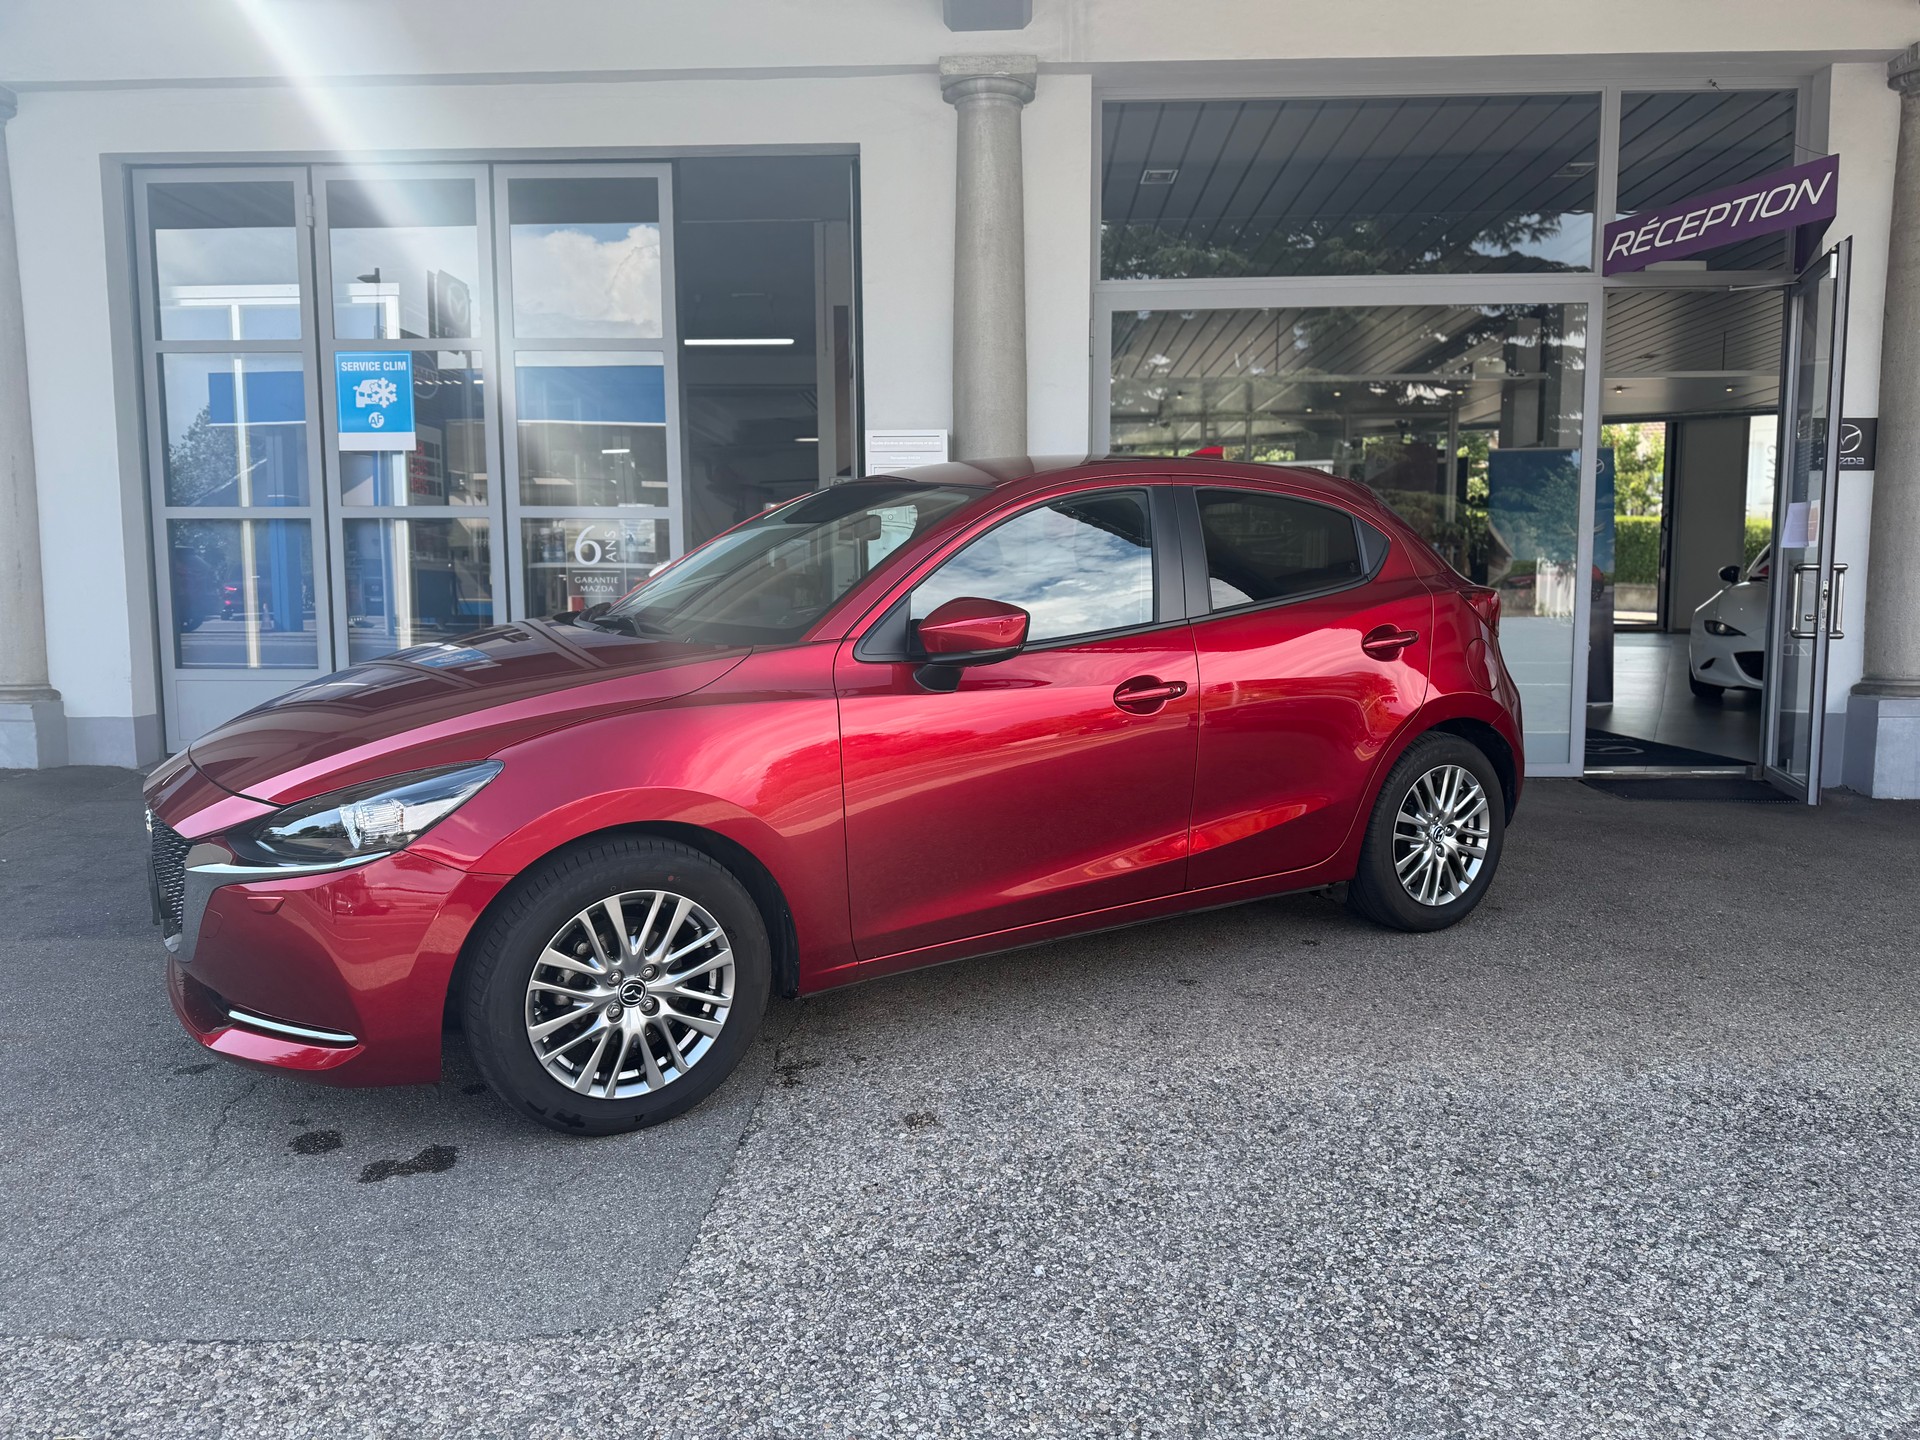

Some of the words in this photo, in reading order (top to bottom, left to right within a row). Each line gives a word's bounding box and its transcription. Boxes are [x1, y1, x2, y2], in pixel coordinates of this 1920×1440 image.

[1606, 171, 1833, 262] RÉCEPTION
[341, 361, 381, 371] SERVICE
[383, 361, 406, 371] CLIM
[370, 414, 383, 426] AF
[574, 525, 602, 566] 6
[604, 530, 617, 562] ANS
[574, 576, 619, 584] GARANTIE
